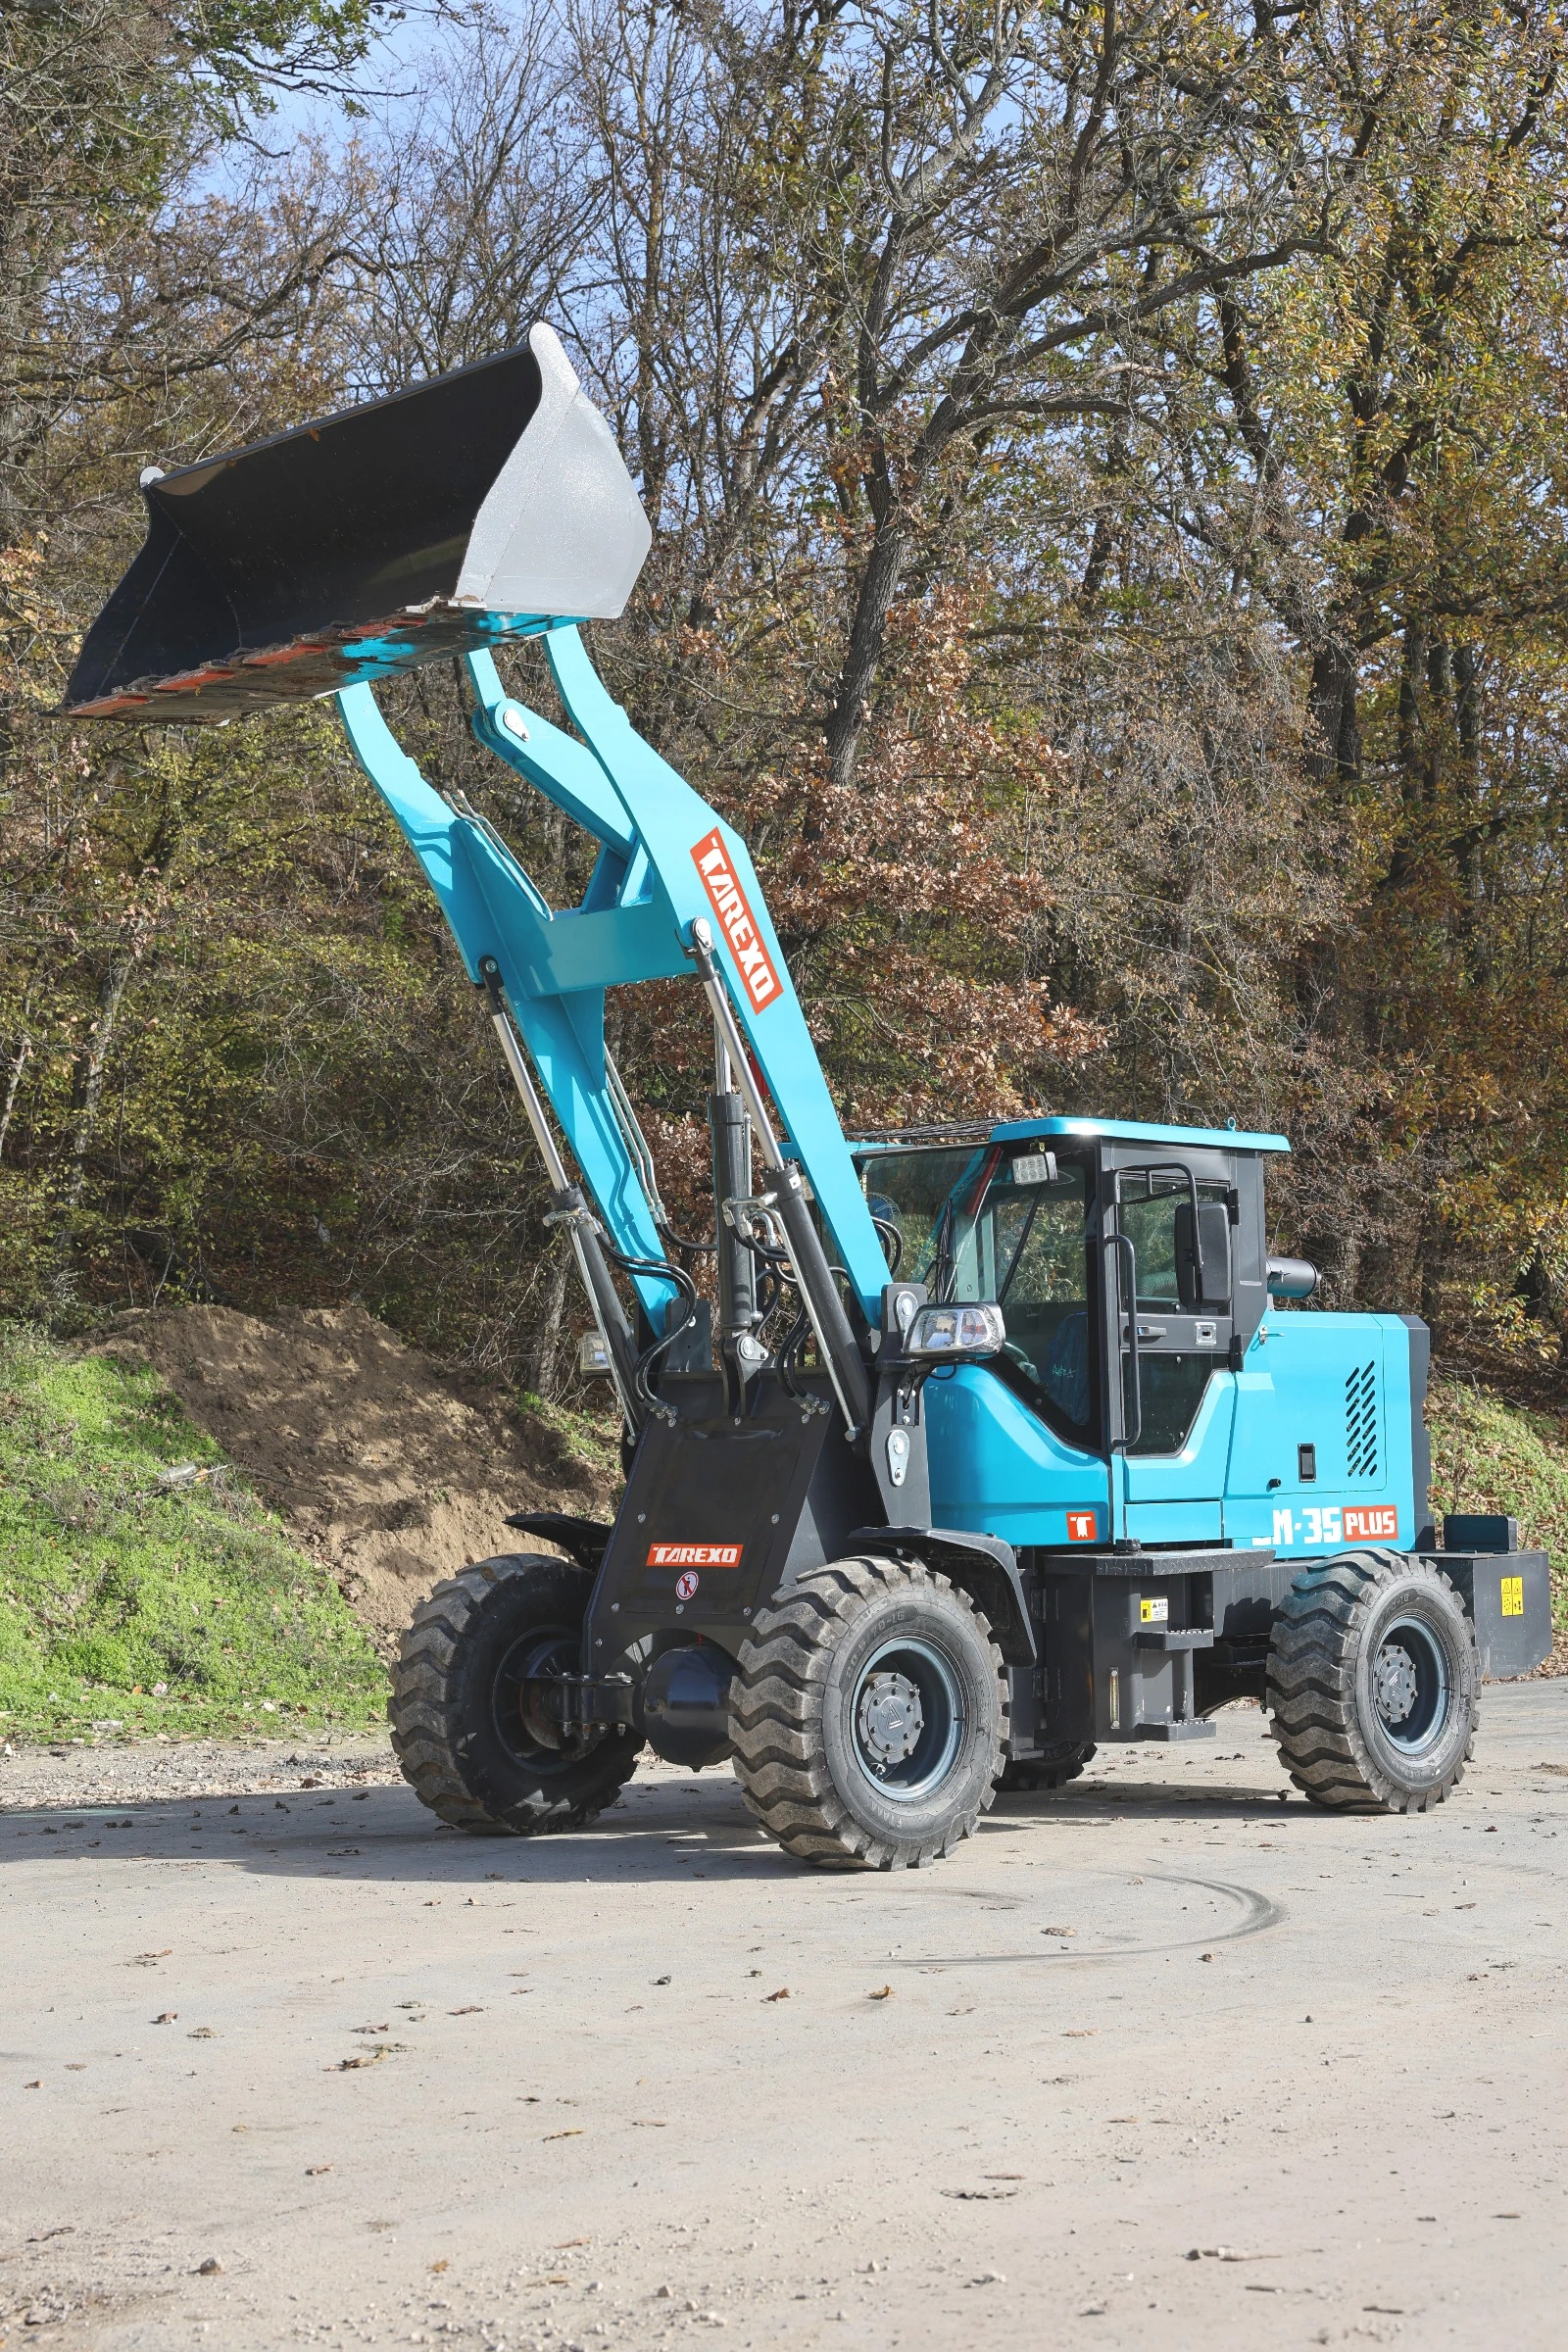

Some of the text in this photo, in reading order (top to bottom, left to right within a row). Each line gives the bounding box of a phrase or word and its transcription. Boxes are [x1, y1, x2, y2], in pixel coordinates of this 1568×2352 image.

[699, 836, 775, 1003] TAREXO
[1271, 1507, 1396, 1545] M-35 PLUS
[653, 1546, 738, 1564] TAREXO
